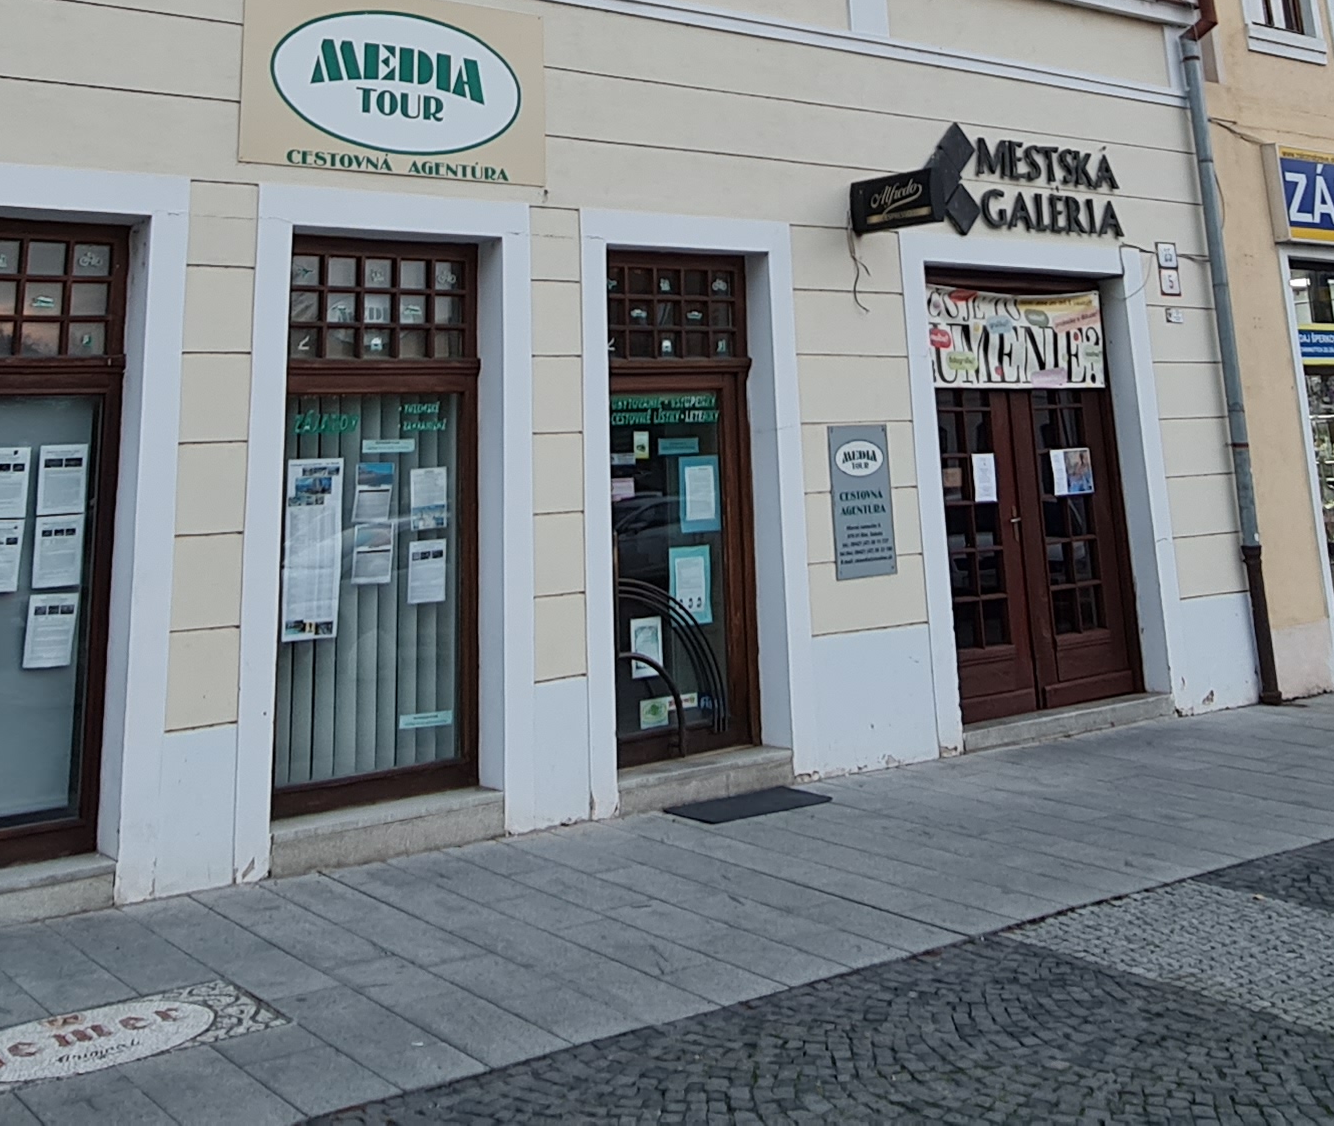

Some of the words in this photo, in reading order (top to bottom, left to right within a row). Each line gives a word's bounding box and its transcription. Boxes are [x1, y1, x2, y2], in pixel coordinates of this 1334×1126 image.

[310, 38, 485, 105] MEDIA
[356, 86, 444, 122] TOUR
[286, 148, 393, 172] CESTOVNÁ
[408, 160, 510, 182] AGENTÚRA
[975, 137, 1120, 191] MESTSKÁ
[870, 178, 923, 212] Alfredo
[980, 185, 1125, 238] GALÉRIA
[842, 450, 878, 464] MEDIA
